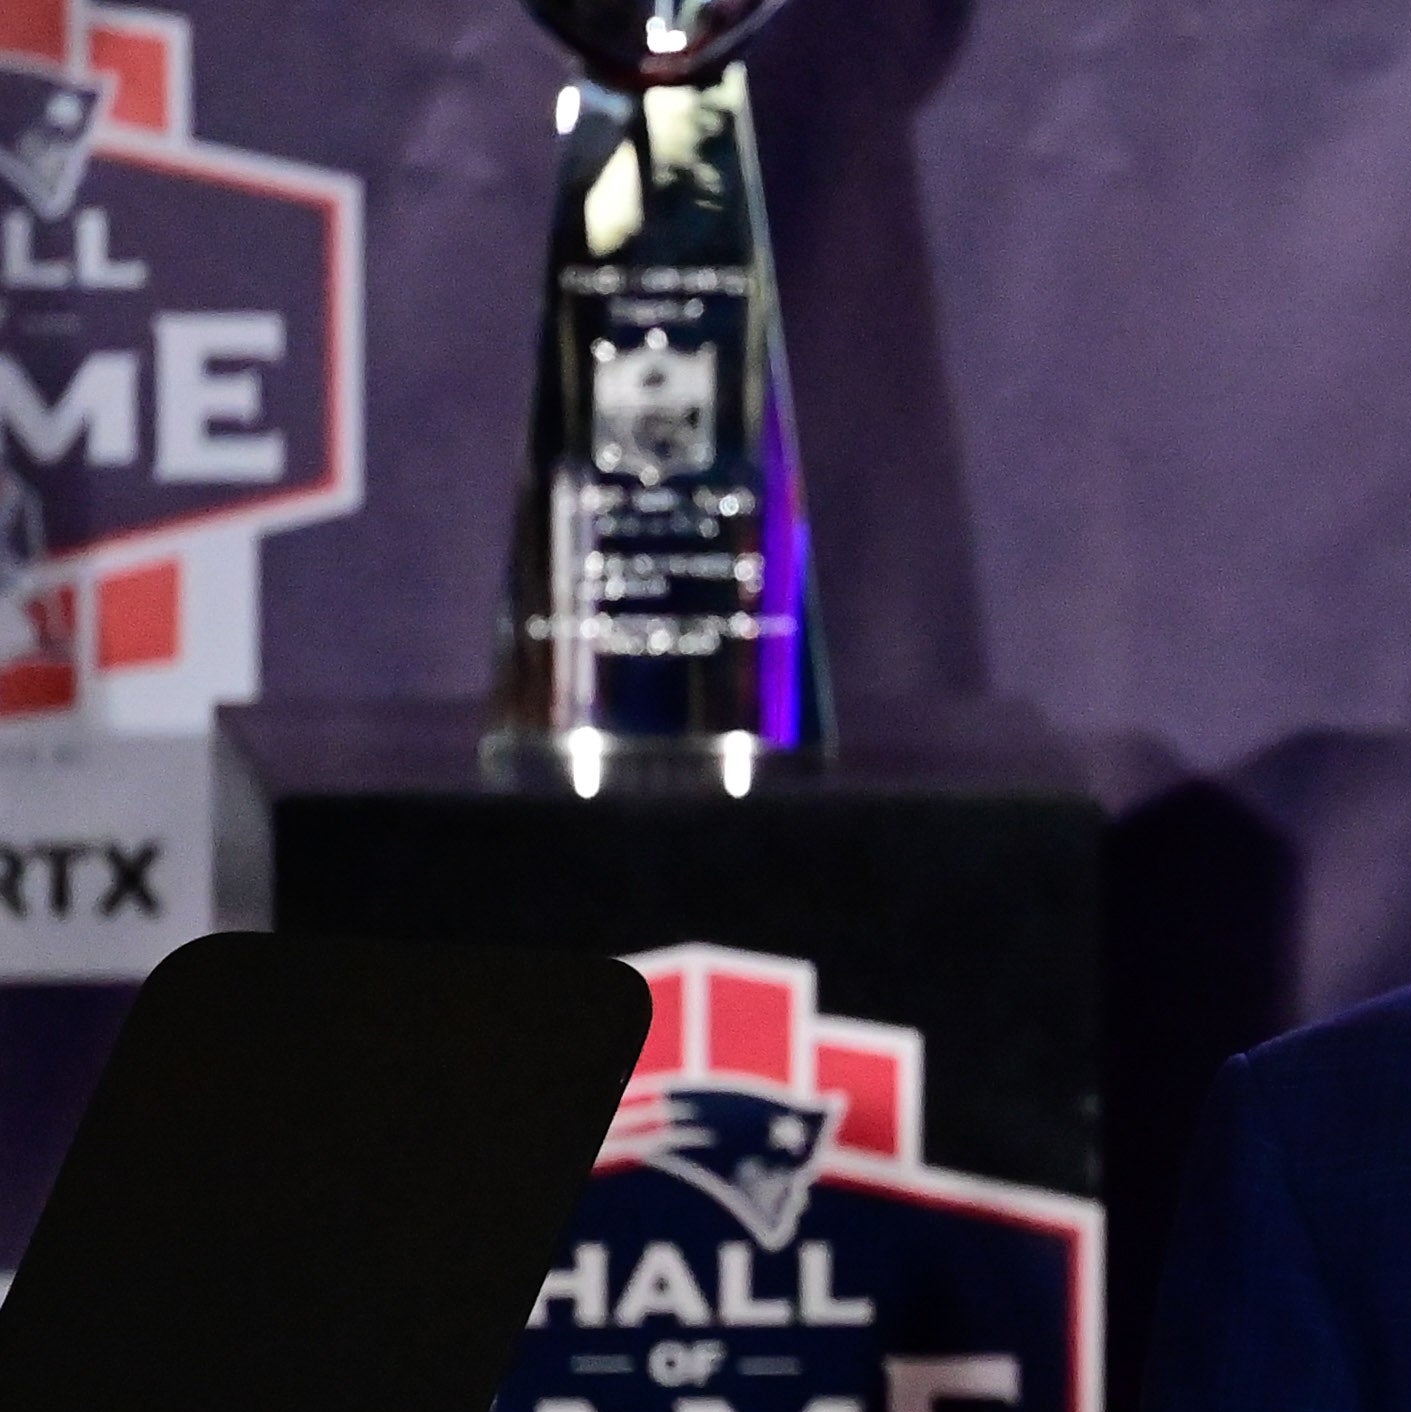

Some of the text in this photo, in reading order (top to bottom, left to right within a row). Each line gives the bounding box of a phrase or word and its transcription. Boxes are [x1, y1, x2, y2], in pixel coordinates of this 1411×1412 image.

[0, 203, 149, 291] LL
[0, 308, 287, 484] ME
[527, 1240, 876, 1329] HALL
[647, 1337, 726, 1388] OF
